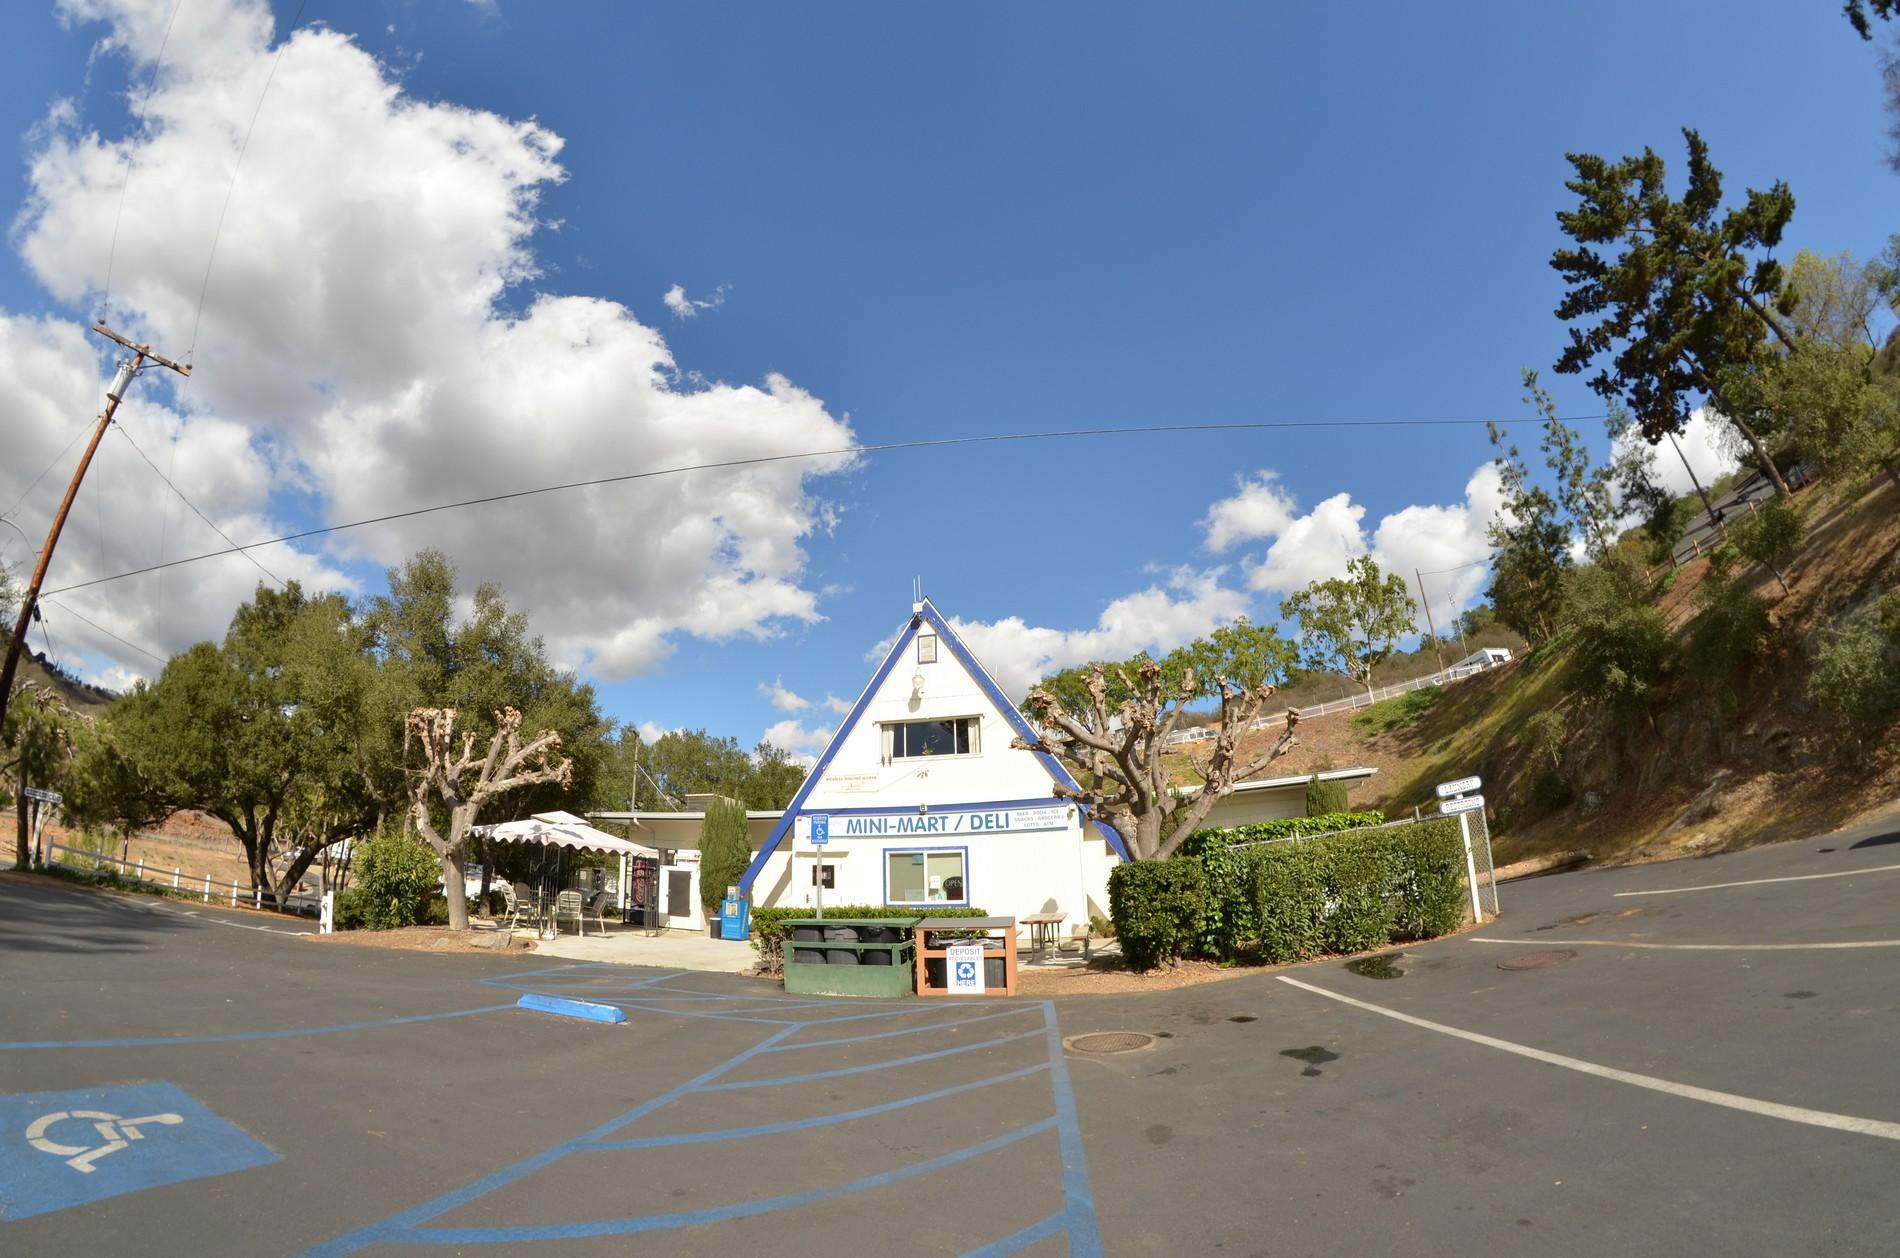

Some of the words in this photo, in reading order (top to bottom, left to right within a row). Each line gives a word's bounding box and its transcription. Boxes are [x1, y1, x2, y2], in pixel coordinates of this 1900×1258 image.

[846, 816, 949, 834] MINI-MART
[970, 812, 1010, 830] DELI
[945, 879, 962, 888] OPEN
[950, 948, 980, 956] DEPOSIT
[957, 979, 976, 987] HERE
